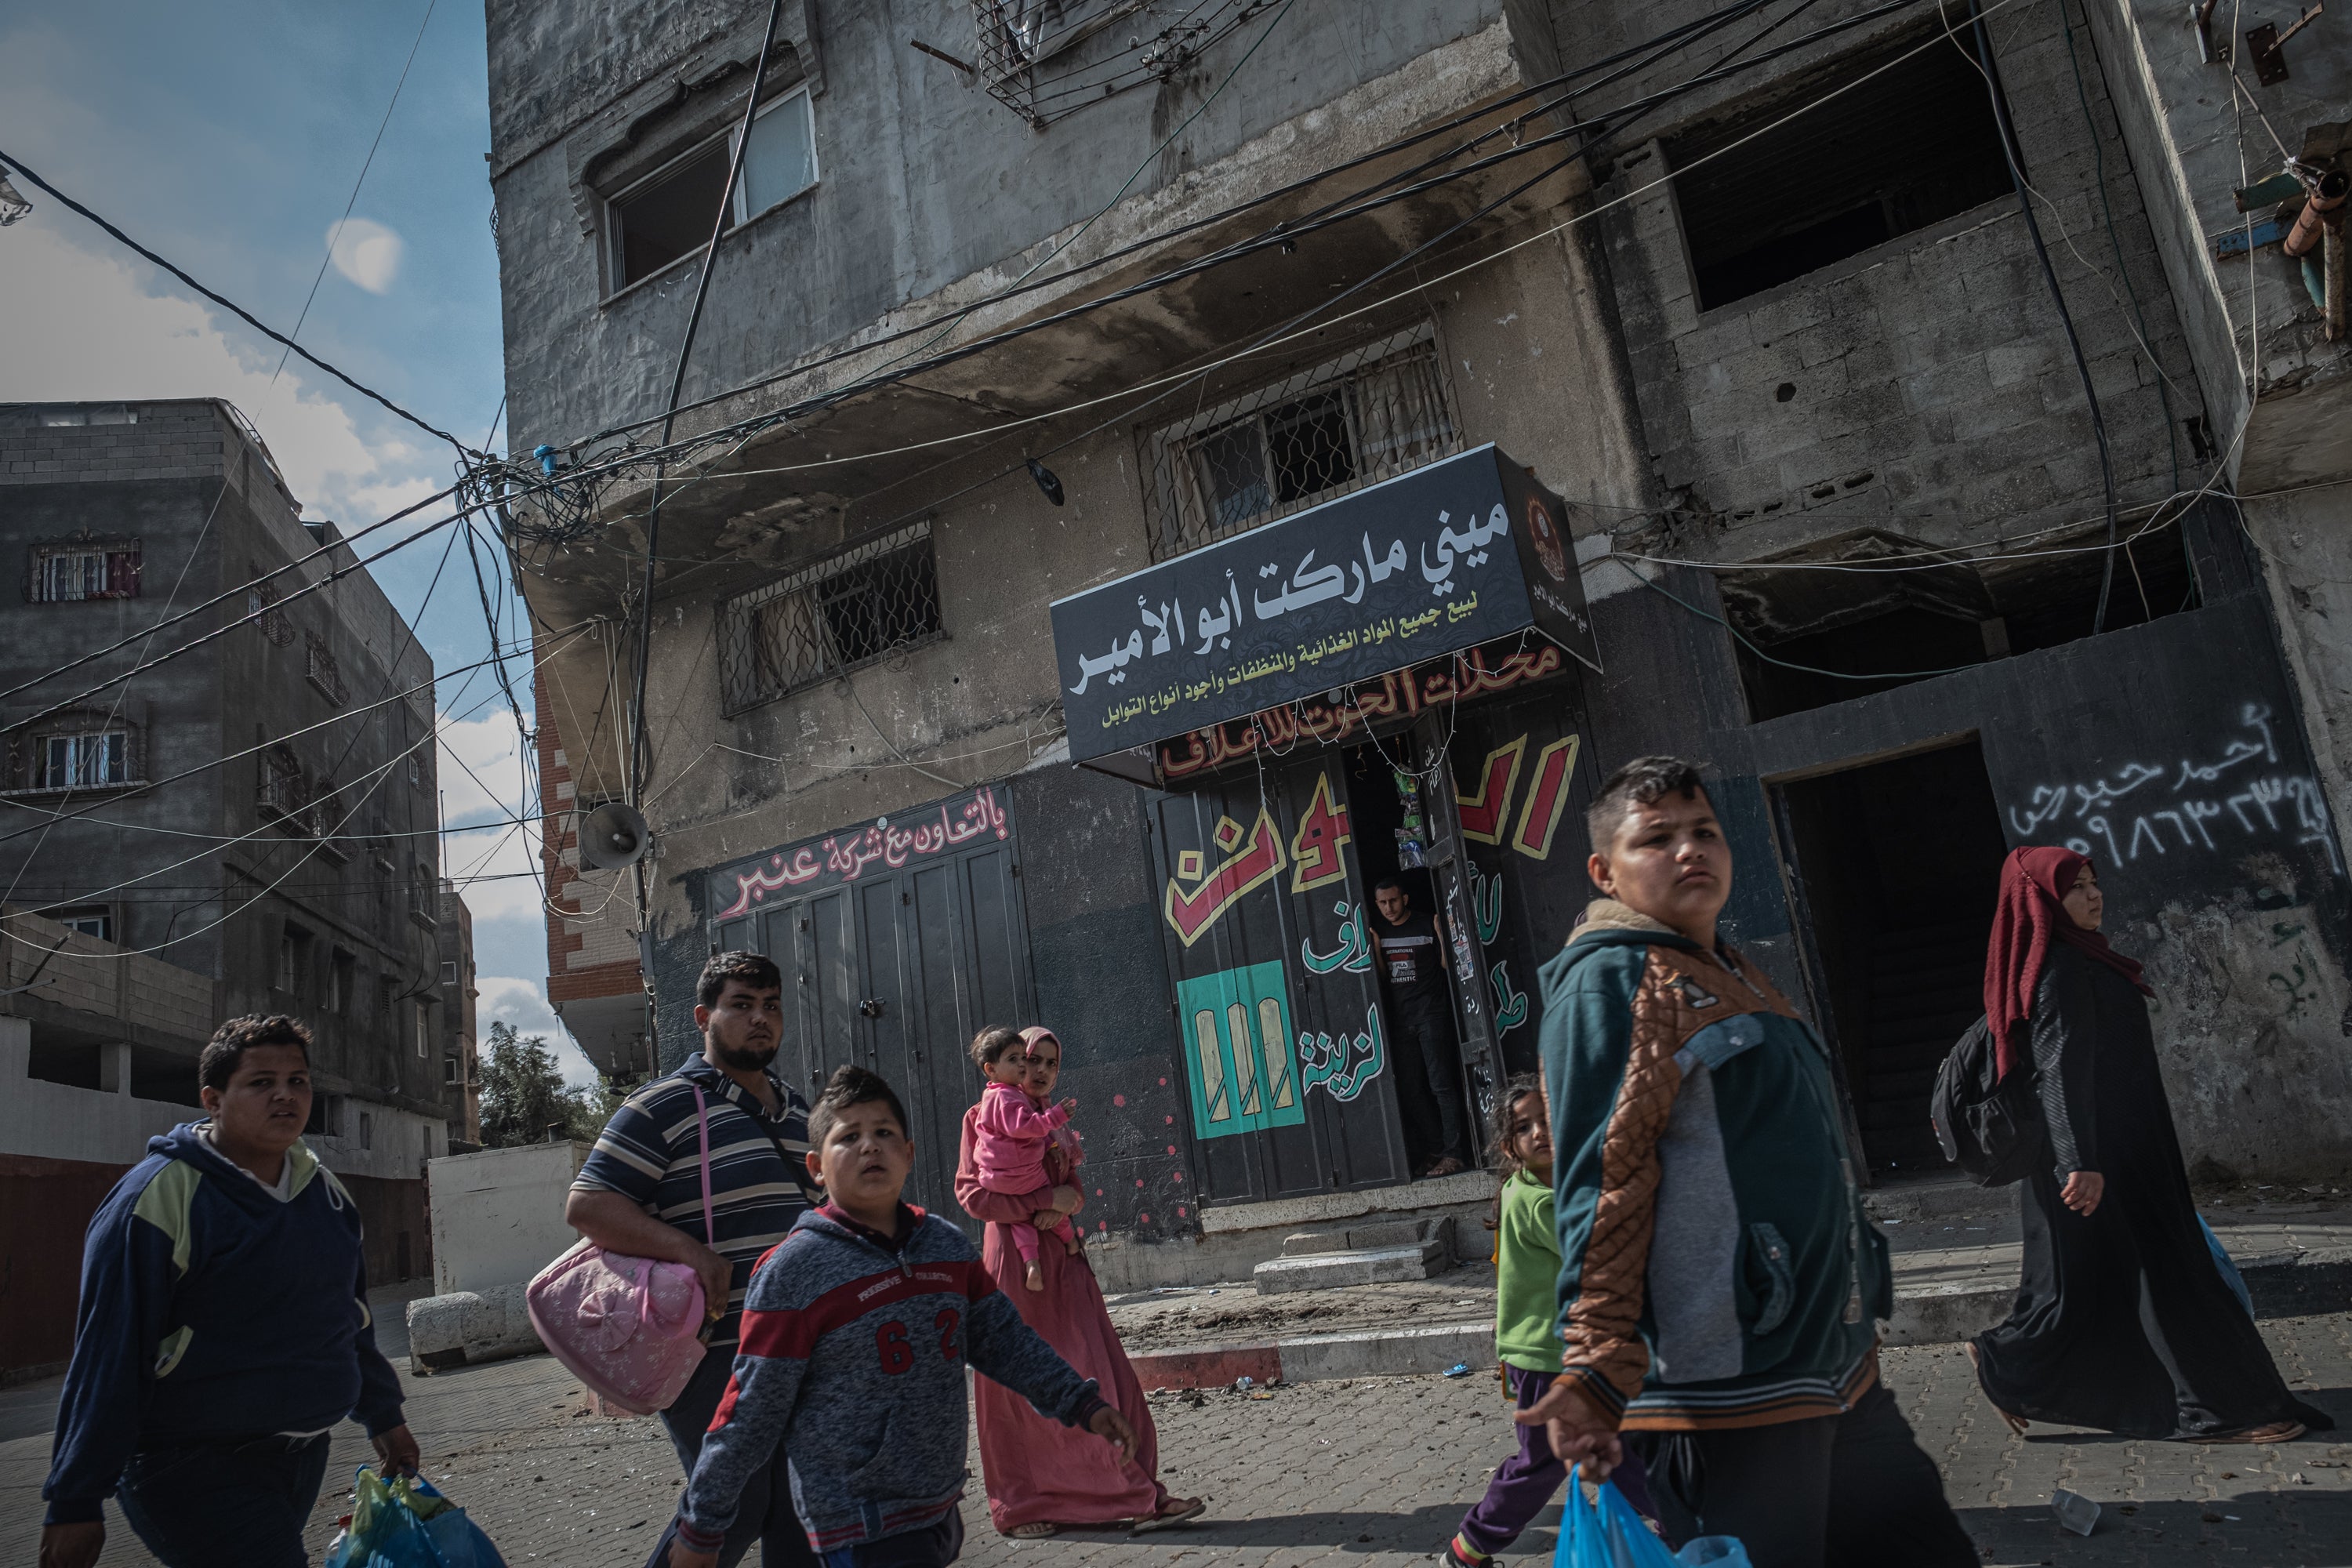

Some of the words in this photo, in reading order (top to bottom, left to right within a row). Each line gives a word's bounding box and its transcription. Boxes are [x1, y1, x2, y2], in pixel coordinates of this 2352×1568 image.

[1254, 530, 1408, 621] ماركت
[1420, 503, 1509, 597] ميني
[1193, 568, 1243, 655] أبو
[1362, 616, 1396, 645] المواد
[1399, 608, 1443, 639] جميع
[1446, 590, 1478, 623] لبيع
[1069, 593, 1185, 695] الأمير
[1226, 649, 1297, 687] والمنظفات
[1297, 628, 1359, 666] الغذائية
[1149, 681, 1181, 715] أنواع
[1185, 671, 1225, 702] وأجود
[1422, 645, 1561, 709] محلات
[1102, 696, 1147, 729] التوابل
[2170, 702, 2280, 792] أحمد
[883, 825, 913, 868] مع
[913, 785, 1007, 855] بالتعاون
[822, 826, 884, 883] شركة
[719, 848, 822, 920] عنبر
[875, 1320, 915, 1375] 6
[934, 1308, 960, 1361] 2
